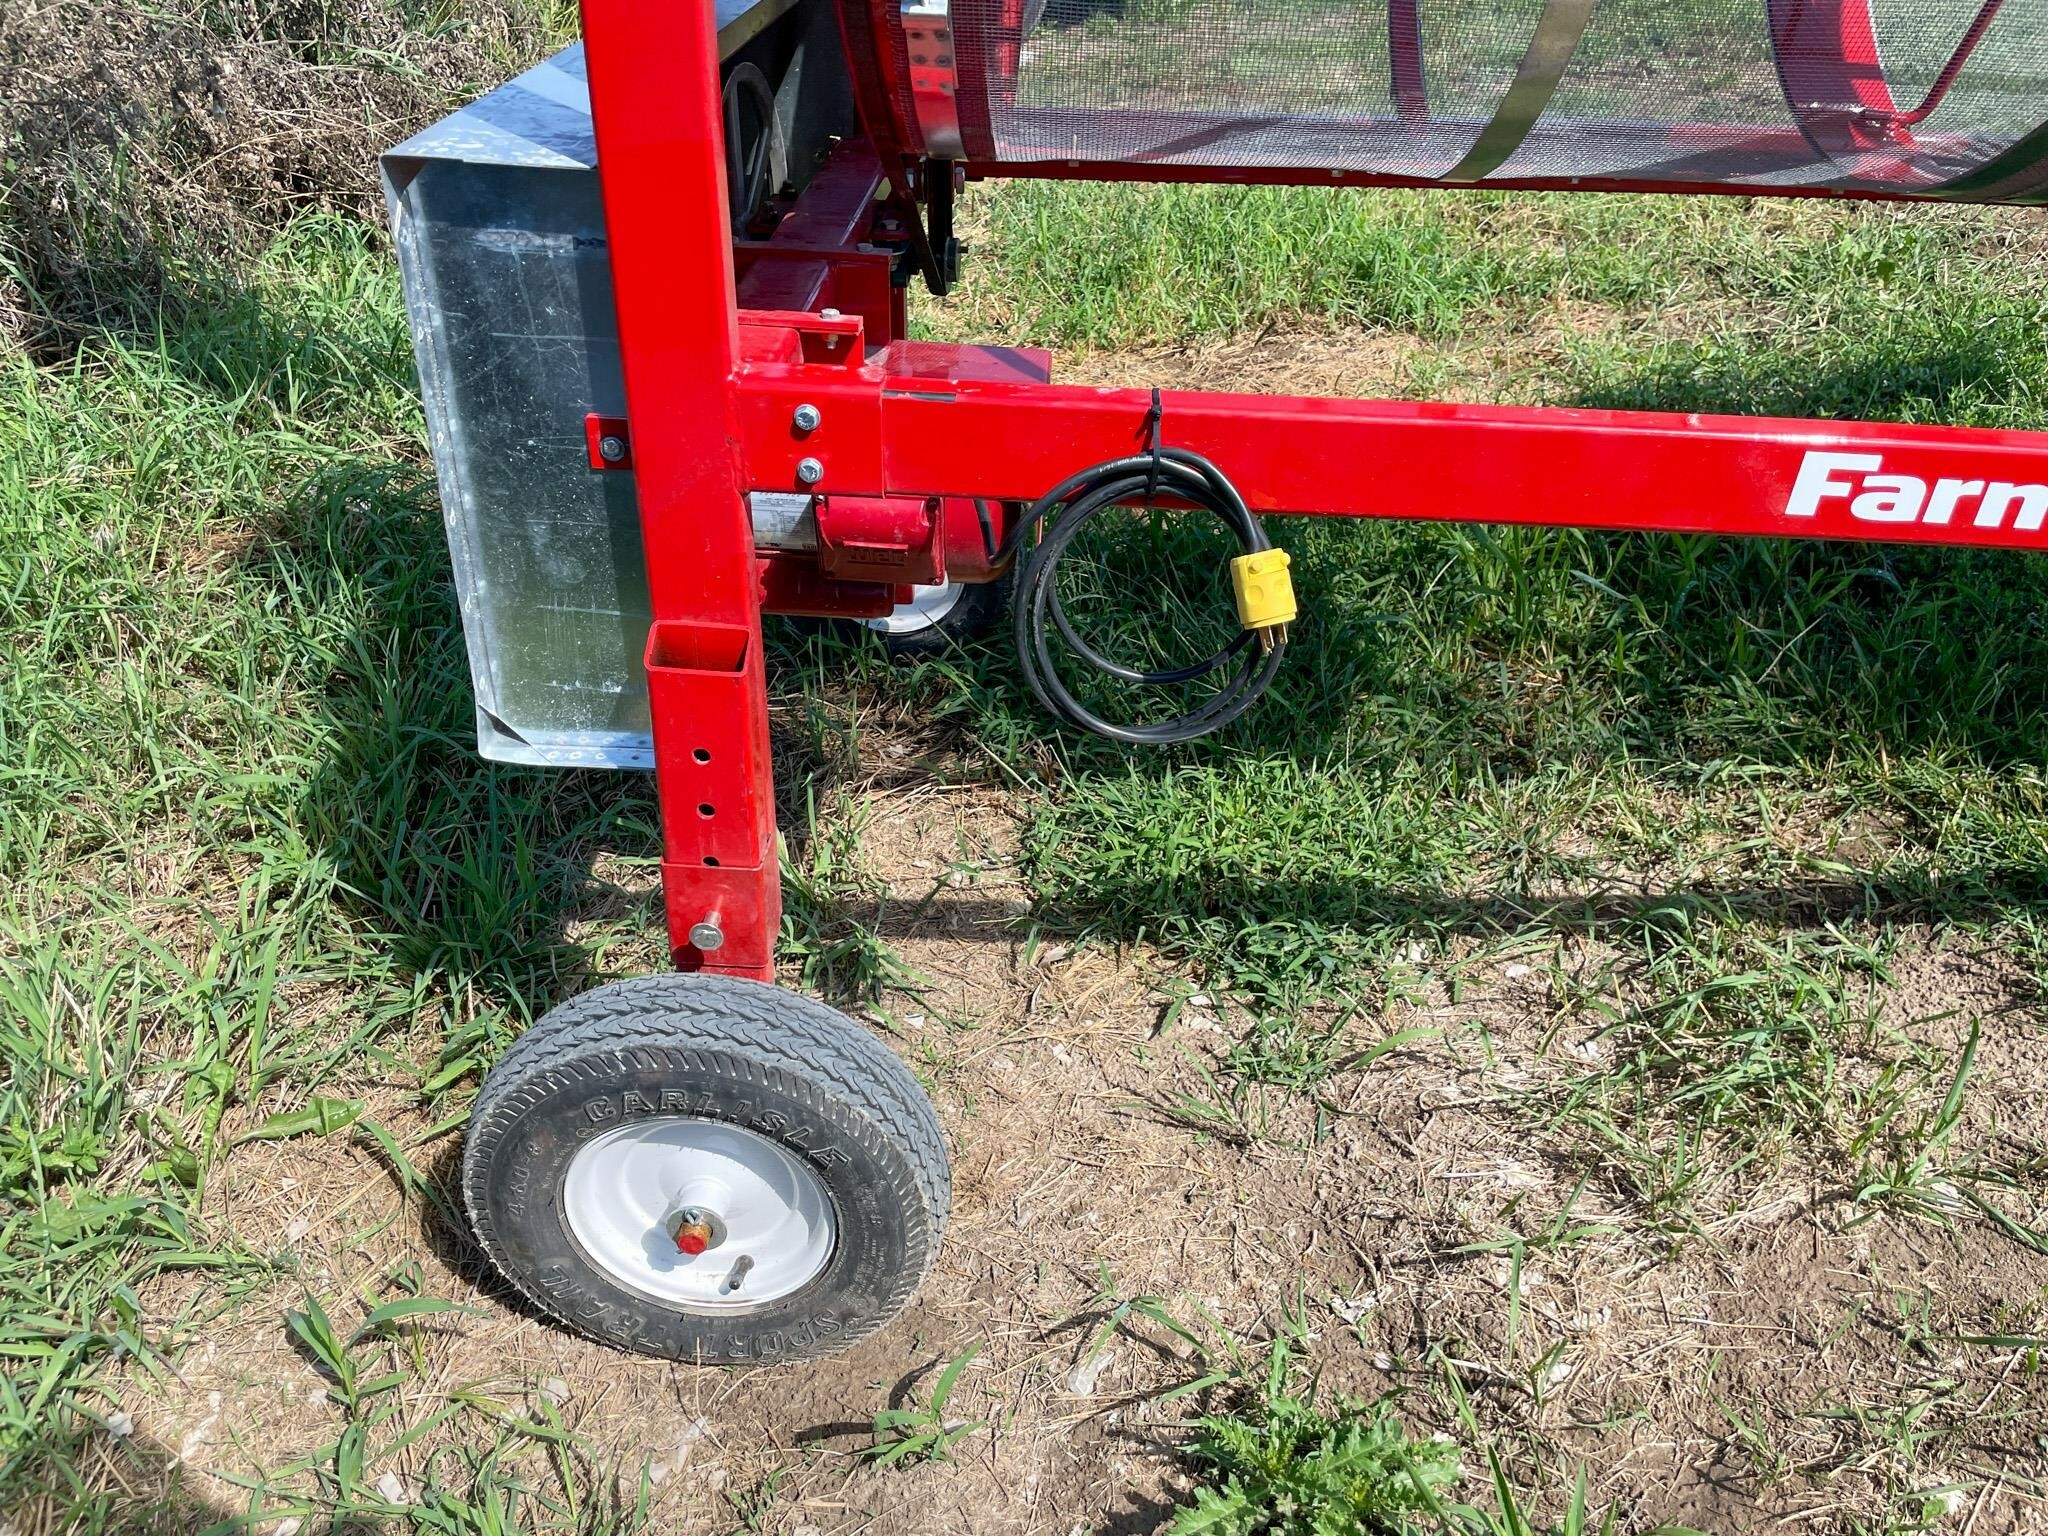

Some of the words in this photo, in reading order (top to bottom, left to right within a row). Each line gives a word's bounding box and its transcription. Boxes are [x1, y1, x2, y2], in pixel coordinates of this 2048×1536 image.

[583, 1088, 852, 1172] CARLISLE
[541, 1264, 665, 1350] TRAIL
[689, 1309, 843, 1359] SPORT
